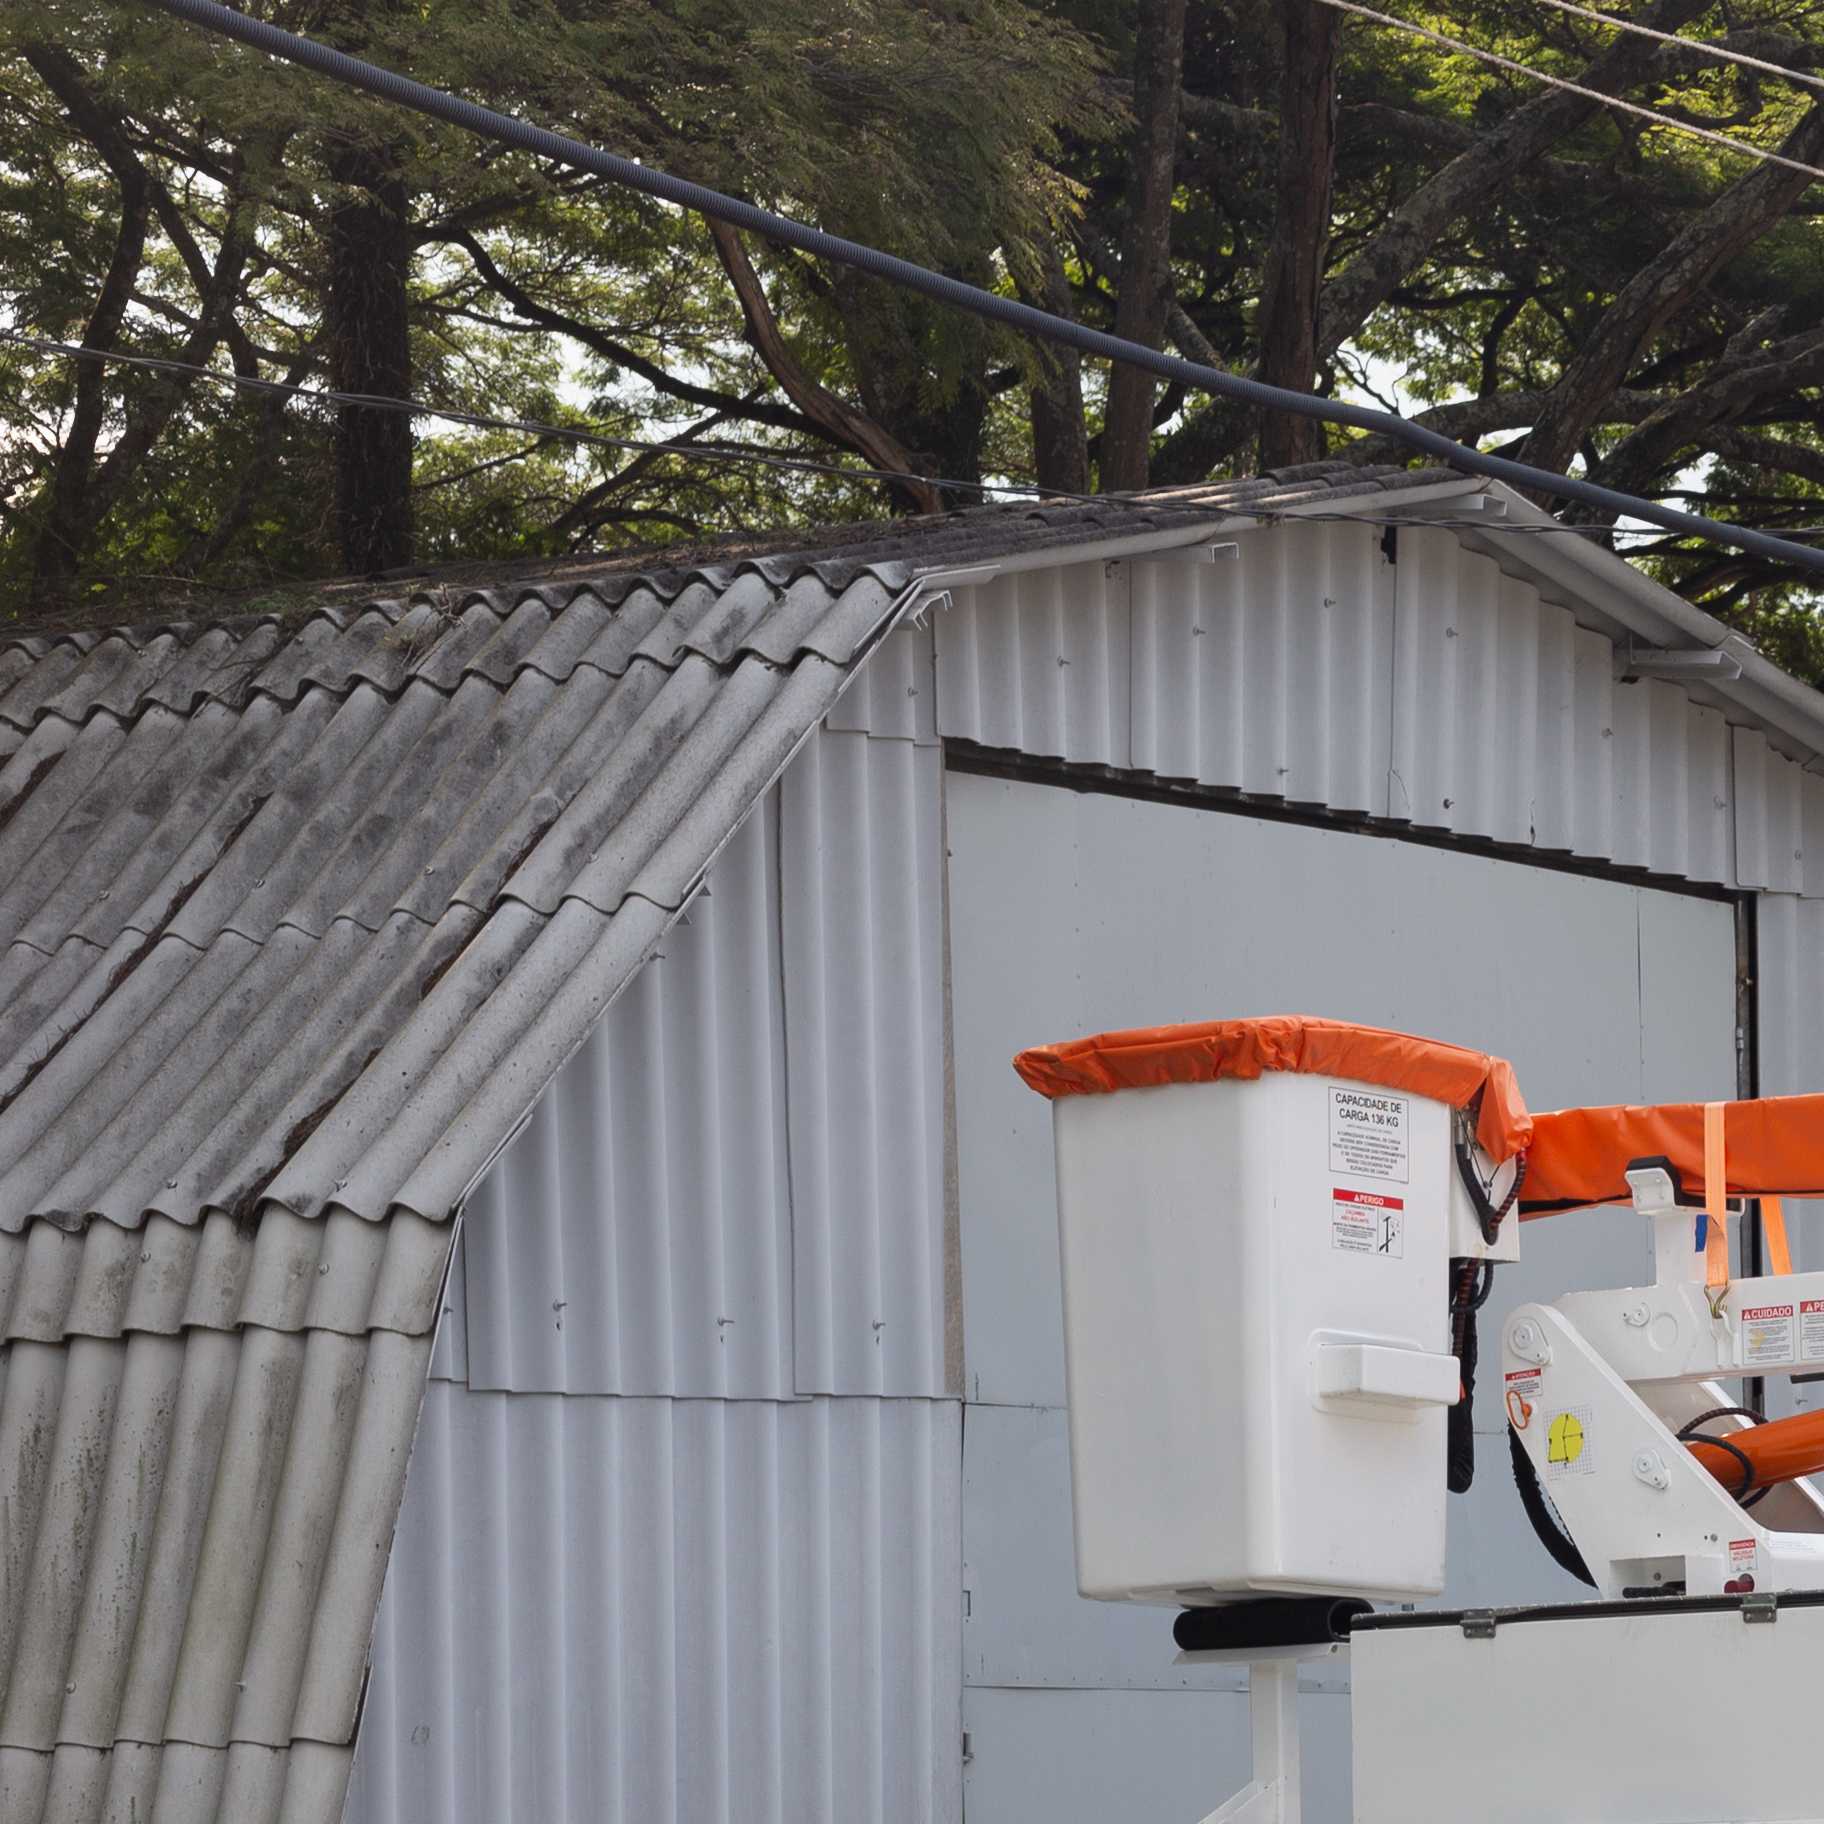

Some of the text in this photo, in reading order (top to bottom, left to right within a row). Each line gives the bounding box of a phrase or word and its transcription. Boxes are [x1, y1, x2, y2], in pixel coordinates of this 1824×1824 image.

[1335, 1093, 1402, 1114] CAPACIDADE DE
[1339, 1108, 1370, 1122] CARGA
[1387, 1116, 1399, 1128] KG
[1751, 1306, 1791, 1319] CUIDADO
